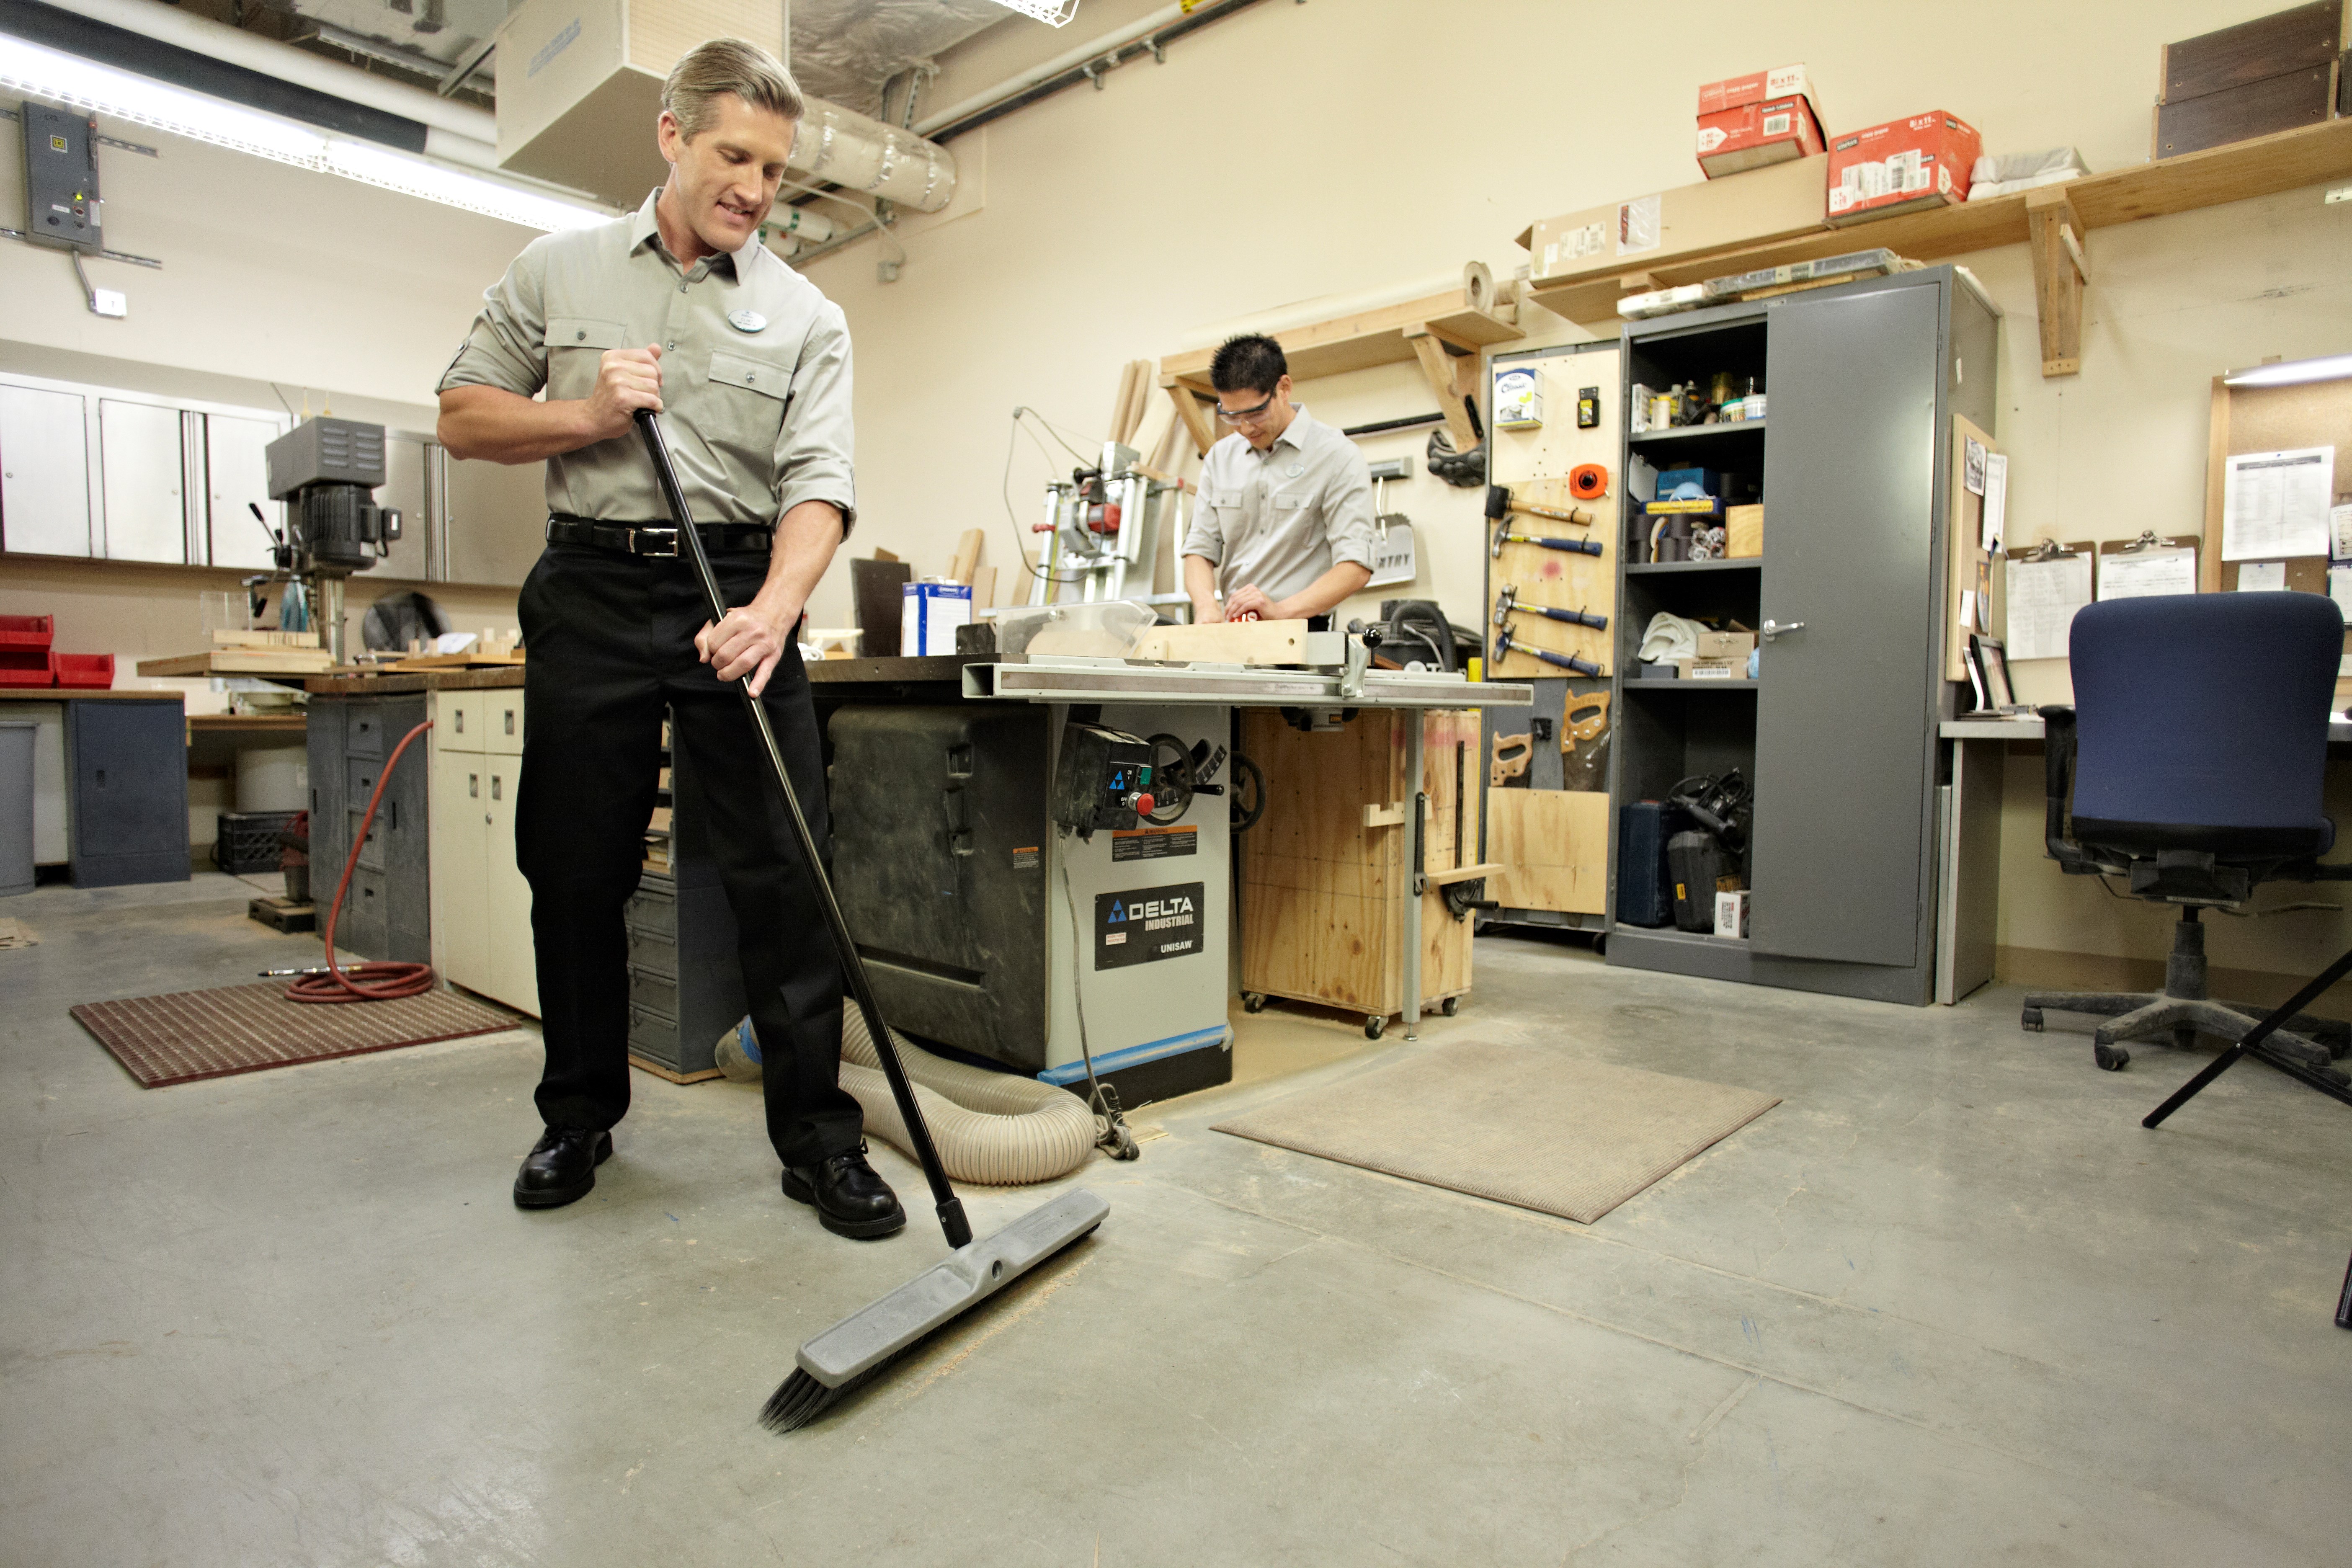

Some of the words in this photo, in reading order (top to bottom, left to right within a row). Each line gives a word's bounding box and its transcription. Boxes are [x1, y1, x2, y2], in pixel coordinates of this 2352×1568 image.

[1129, 897, 1194, 921] DELTA
[1145, 914, 1194, 931] INDUSTRIAL
[1161, 941, 1192, 953] UNISAW
